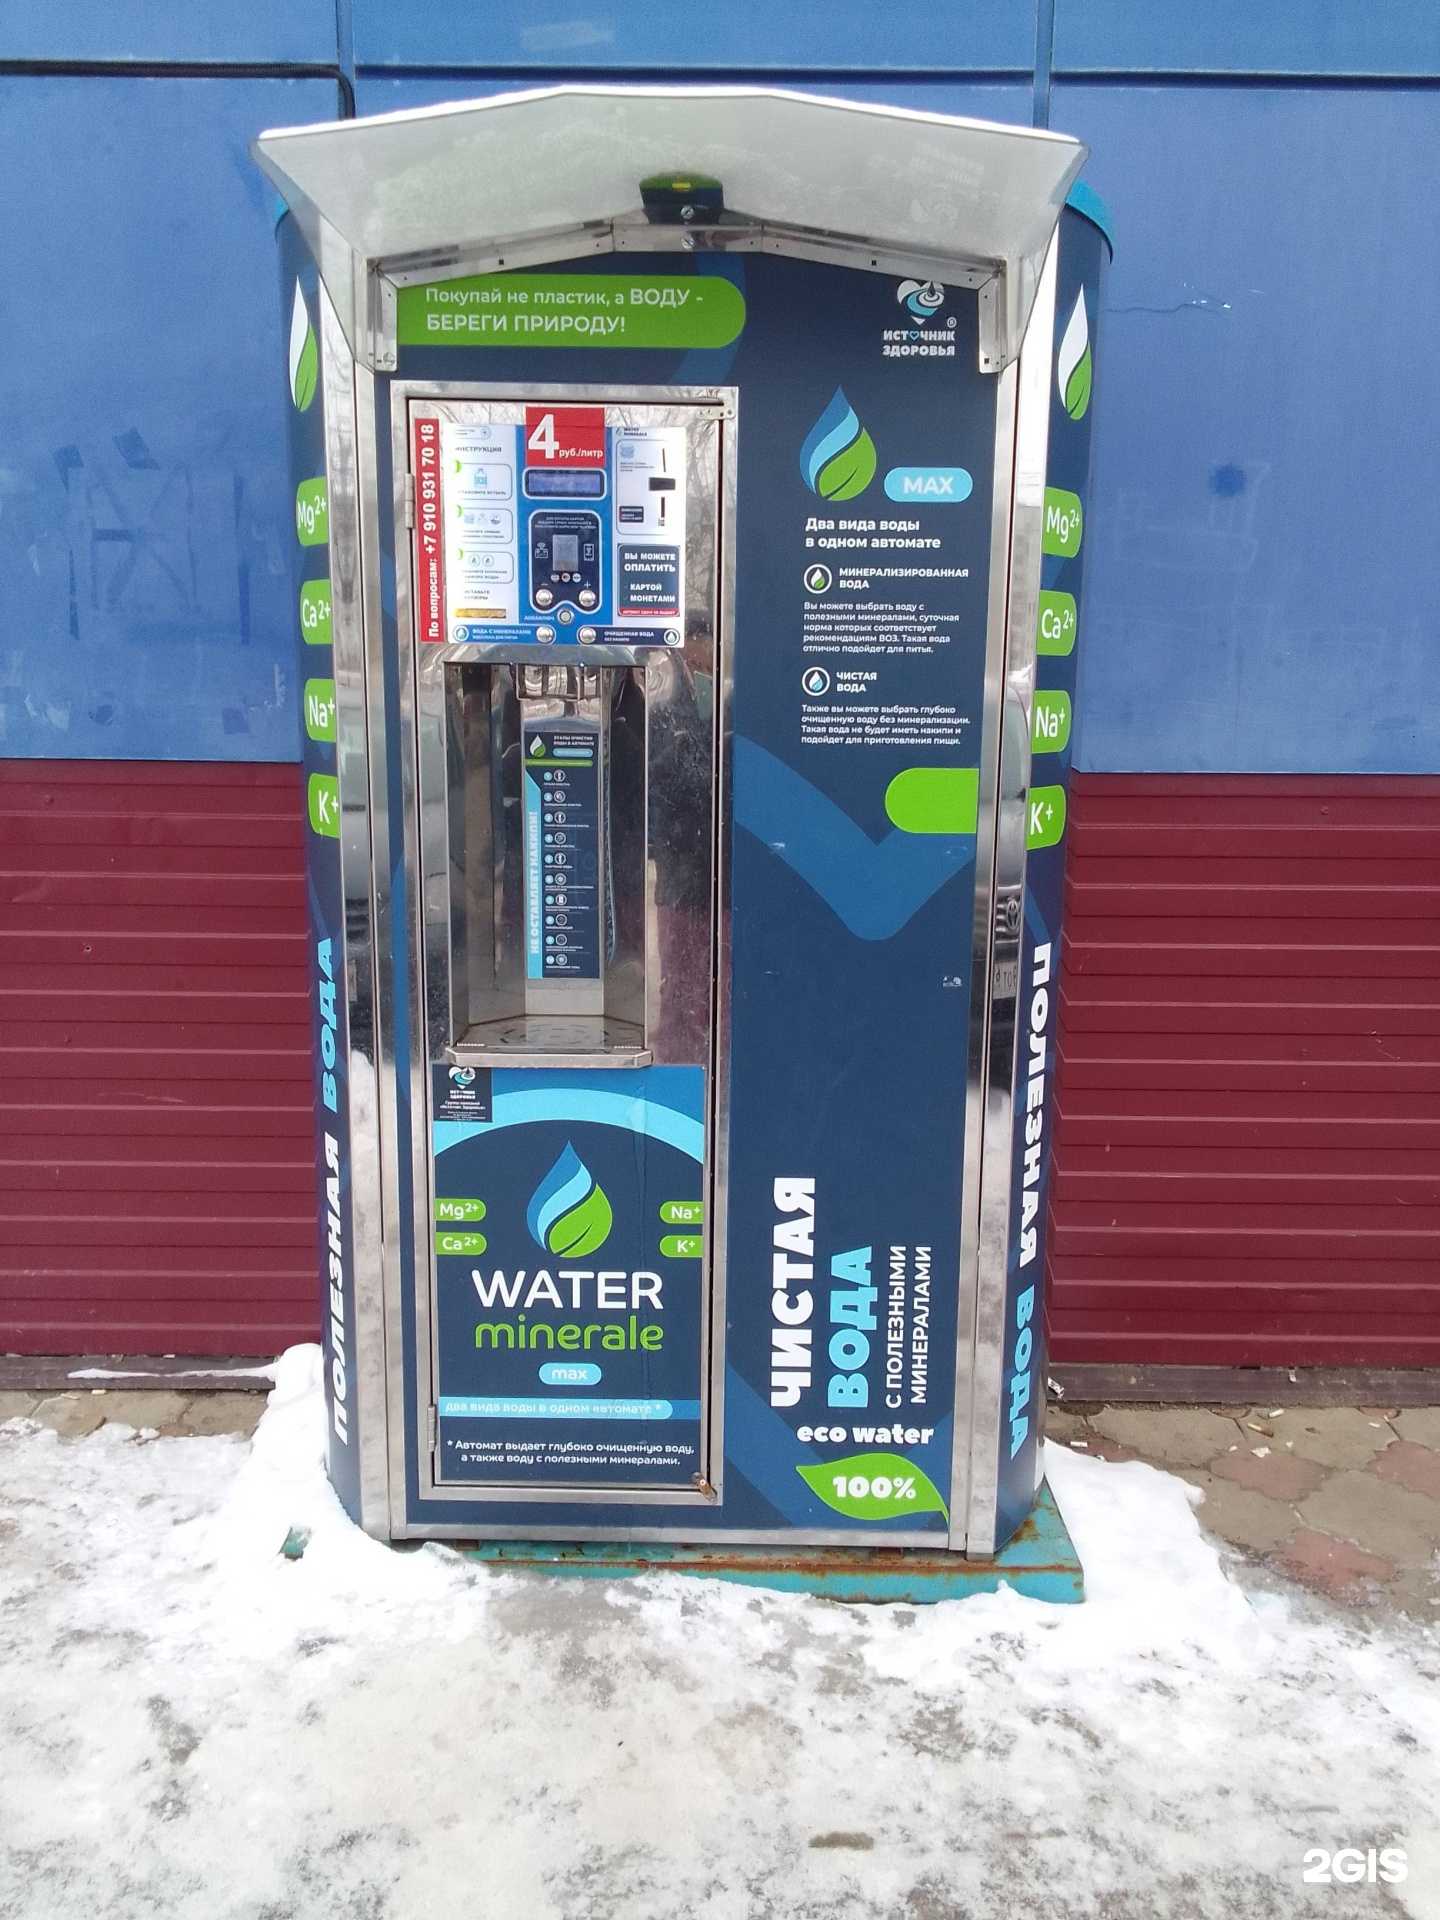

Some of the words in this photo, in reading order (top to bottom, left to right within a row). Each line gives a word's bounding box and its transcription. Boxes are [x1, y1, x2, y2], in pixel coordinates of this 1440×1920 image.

[425, 288, 502, 306] Покупай
[507, 291, 528, 304] не
[533, 291, 610, 306] пластик,
[615, 294, 625, 305] а
[630, 289, 691, 307] ВОДУ
[427, 314, 507, 331] БЕРЕГИ
[514, 315, 626, 334] ПРИРОДУ!
[883, 345, 955, 357] ЗДОРОВЬЯ
[420, 424, 434, 442] 18
[528, 414, 559, 459] 4
[559, 448, 603, 459] руб./литр
[421, 447, 435, 466] 70
[422, 472, 435, 499] 931
[904, 477, 953, 494] MAX
[423, 503, 436, 531] 910
[805, 518, 834, 531] Два
[839, 521, 876, 532] вида
[880, 521, 920, 532] воды
[424, 535, 437, 554] +7
[806, 538, 814, 547] в
[818, 538, 867, 549] одном
[871, 539, 941, 549] автомате
[641, 553, 676, 561] МОЖЕТЕ
[624, 564, 676, 572] ОПЛАТИТЬ
[839, 568, 969, 577] МИНЕРАЛИЗИРОВАННАЯ
[429, 559, 441, 618] вопросам:
[839, 580, 870, 589] ВОДА
[804, 602, 817, 610] Вы
[855, 602, 893, 612] выбрать
[896, 604, 916, 612] воду
[804, 613, 855, 621] полезными
[858, 614, 918, 622] минералами,
[428, 622, 439, 638] По
[804, 624, 832, 632] норма
[834, 624, 872, 632] которых
[874, 624, 936, 633] соответствует
[803, 635, 877, 643] рекомендациям
[842, 645, 885, 653] подойдет
[887, 646, 904, 654] для
[836, 672, 877, 681] ЧИСТАЯ
[837, 683, 866, 693] ВОДА
[802, 704, 829, 712] Также
[881, 705, 919, 714] выбрать
[921, 705, 956, 715] глубоко
[801, 716, 854, 724] очищенную
[857, 716, 878, 724] воду
[879, 715, 895, 724] без
[864, 726, 890, 734] будет
[920, 727, 953, 735] накипи
[801, 736, 844, 745] подойдет
[845, 737, 862, 745] для
[864, 737, 932, 746] приготовления
[317, 937, 338, 1114] ВОДА
[1019, 942, 1051, 1269] ПОЛЕЗНАЯ
[323, 1132, 348, 1445] ПОЛЕЗНАЯ
[471, 1269, 664, 1310] WATER
[770, 1177, 816, 1407] ЧИСТАЯ
[886, 1246, 906, 1388] ПОЛЕЗНЫМИ
[475, 1313, 664, 1351] minerale
[828, 1246, 878, 1408] ВОДА
[911, 1247, 931, 1404] МИНЕРАЛАМИ
[551, 1368, 588, 1380] max
[1010, 1284, 1035, 1461] ВОДА
[885, 1394, 902, 1409] С
[796, 1426, 847, 1443] eco
[852, 1424, 934, 1444] water
[455, 1440, 503, 1450] Автомат
[505, 1442, 545, 1452] выдает
[548, 1441, 594, 1453] глубоко
[596, 1443, 663, 1454] очищенную
[665, 1444, 694, 1454] воду,
[469, 1454, 504, 1463] также
[506, 1455, 534, 1465] воду
[544, 1456, 607, 1464] полезными
[609, 1456, 680, 1466] минералами.
[832, 1475, 916, 1499] 100%
